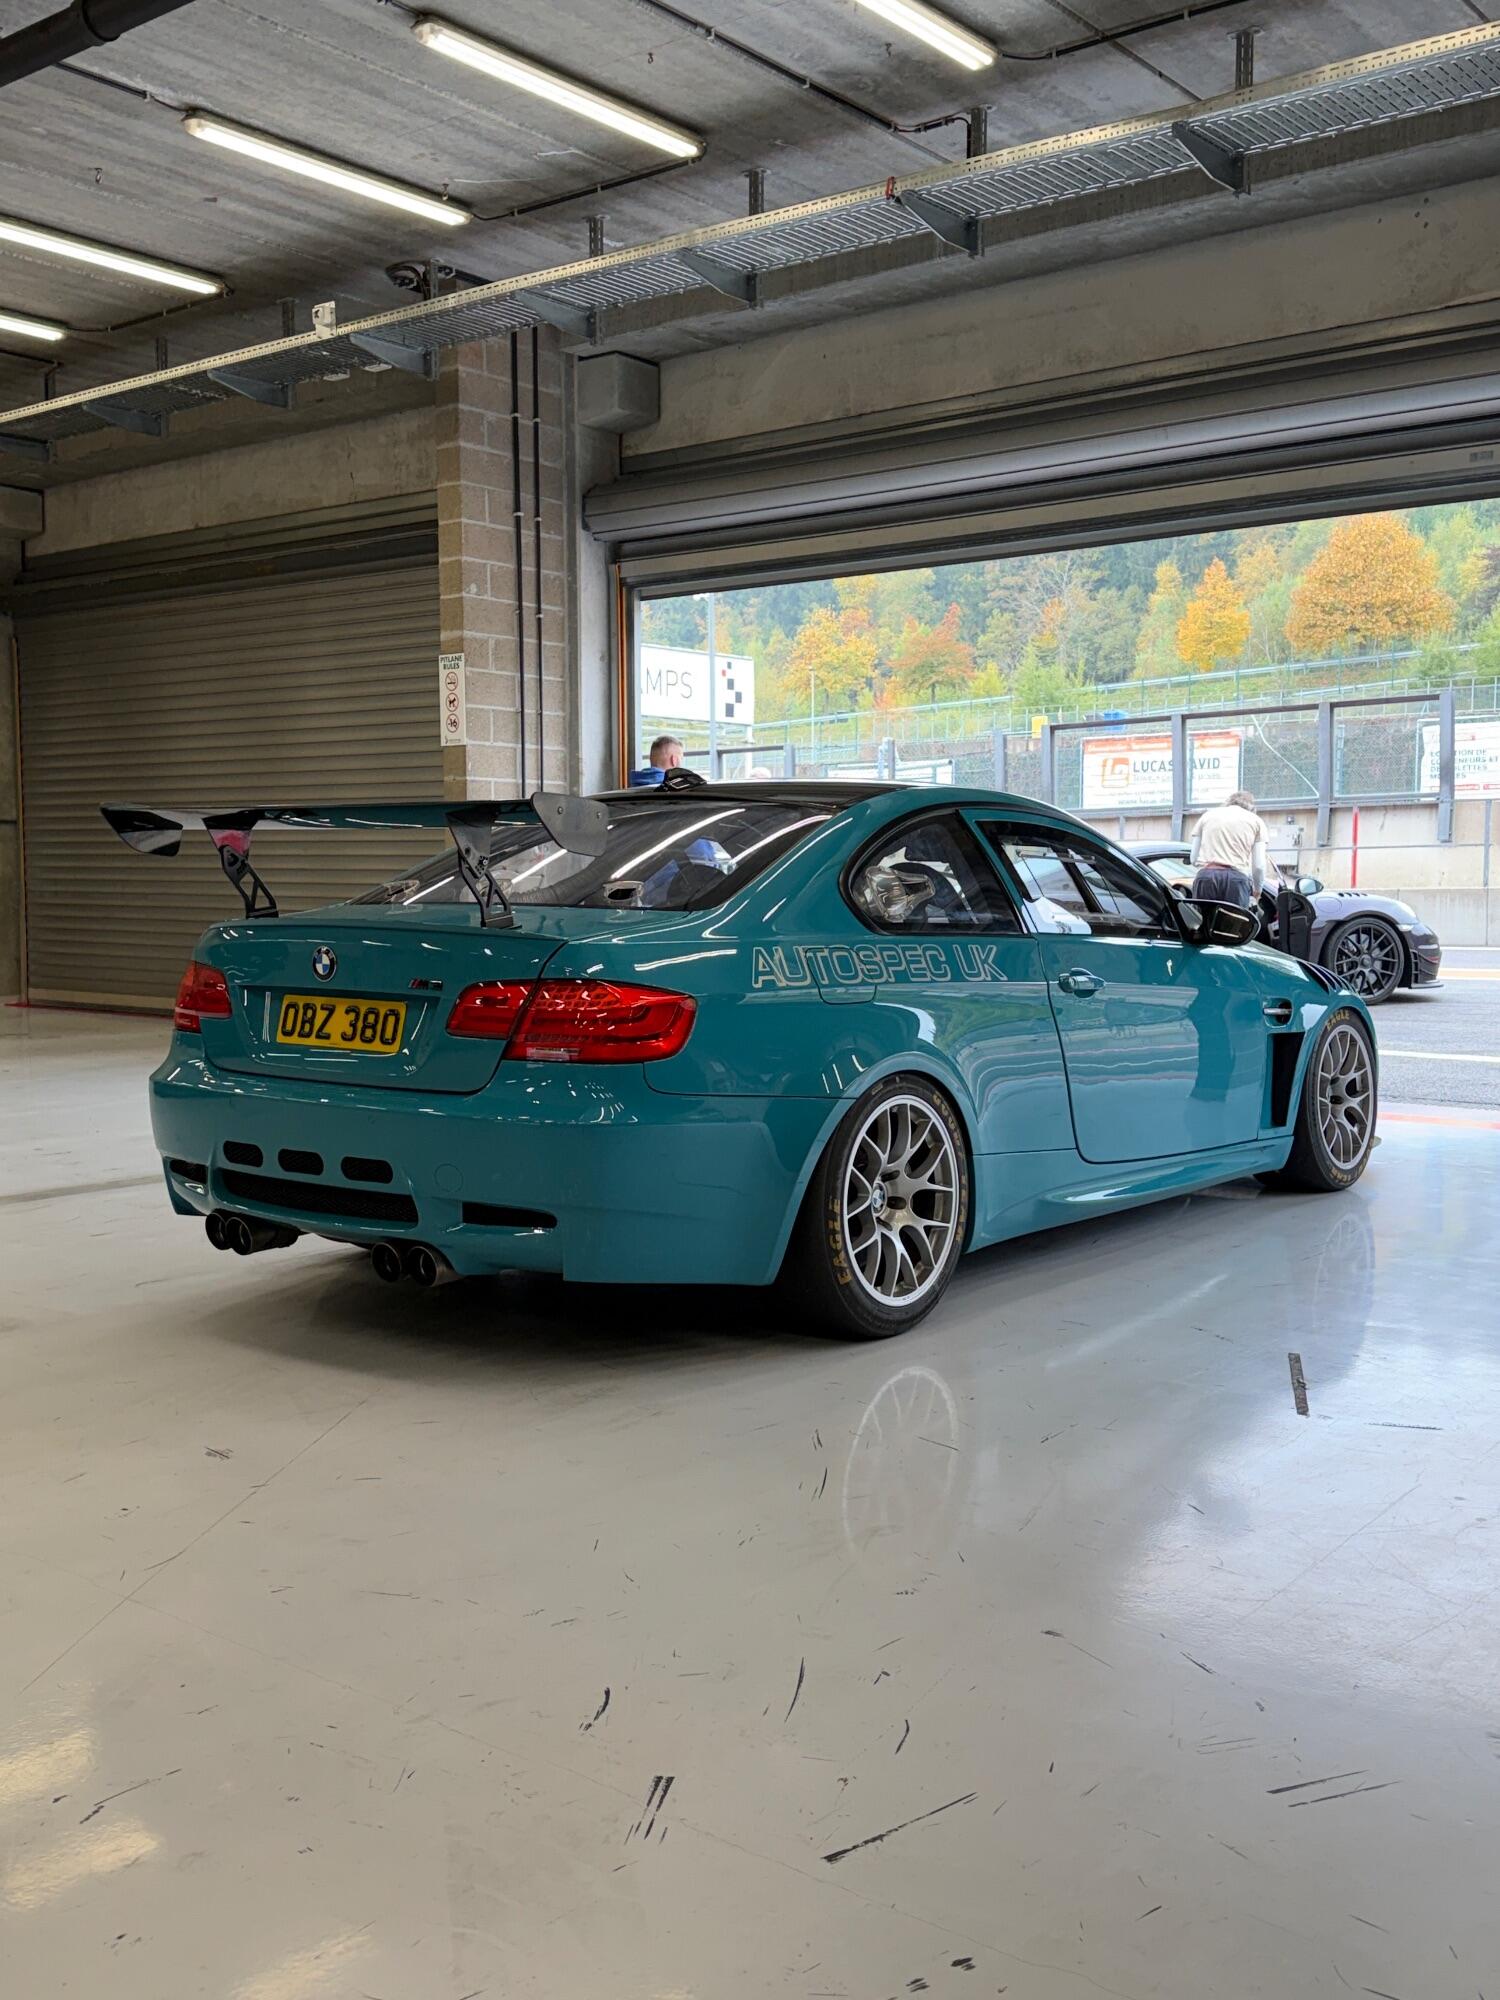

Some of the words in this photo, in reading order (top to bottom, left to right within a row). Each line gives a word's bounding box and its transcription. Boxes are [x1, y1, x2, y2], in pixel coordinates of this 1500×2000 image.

[440, 655, 462, 664] PITLANE
[640, 667, 693, 699] MPS
[1133, 759, 1173, 773] LUCAS
[752, 944, 950, 988] AUTOSPEC
[953, 944, 1008, 982] UK
[340, 1005, 401, 1046] 380
